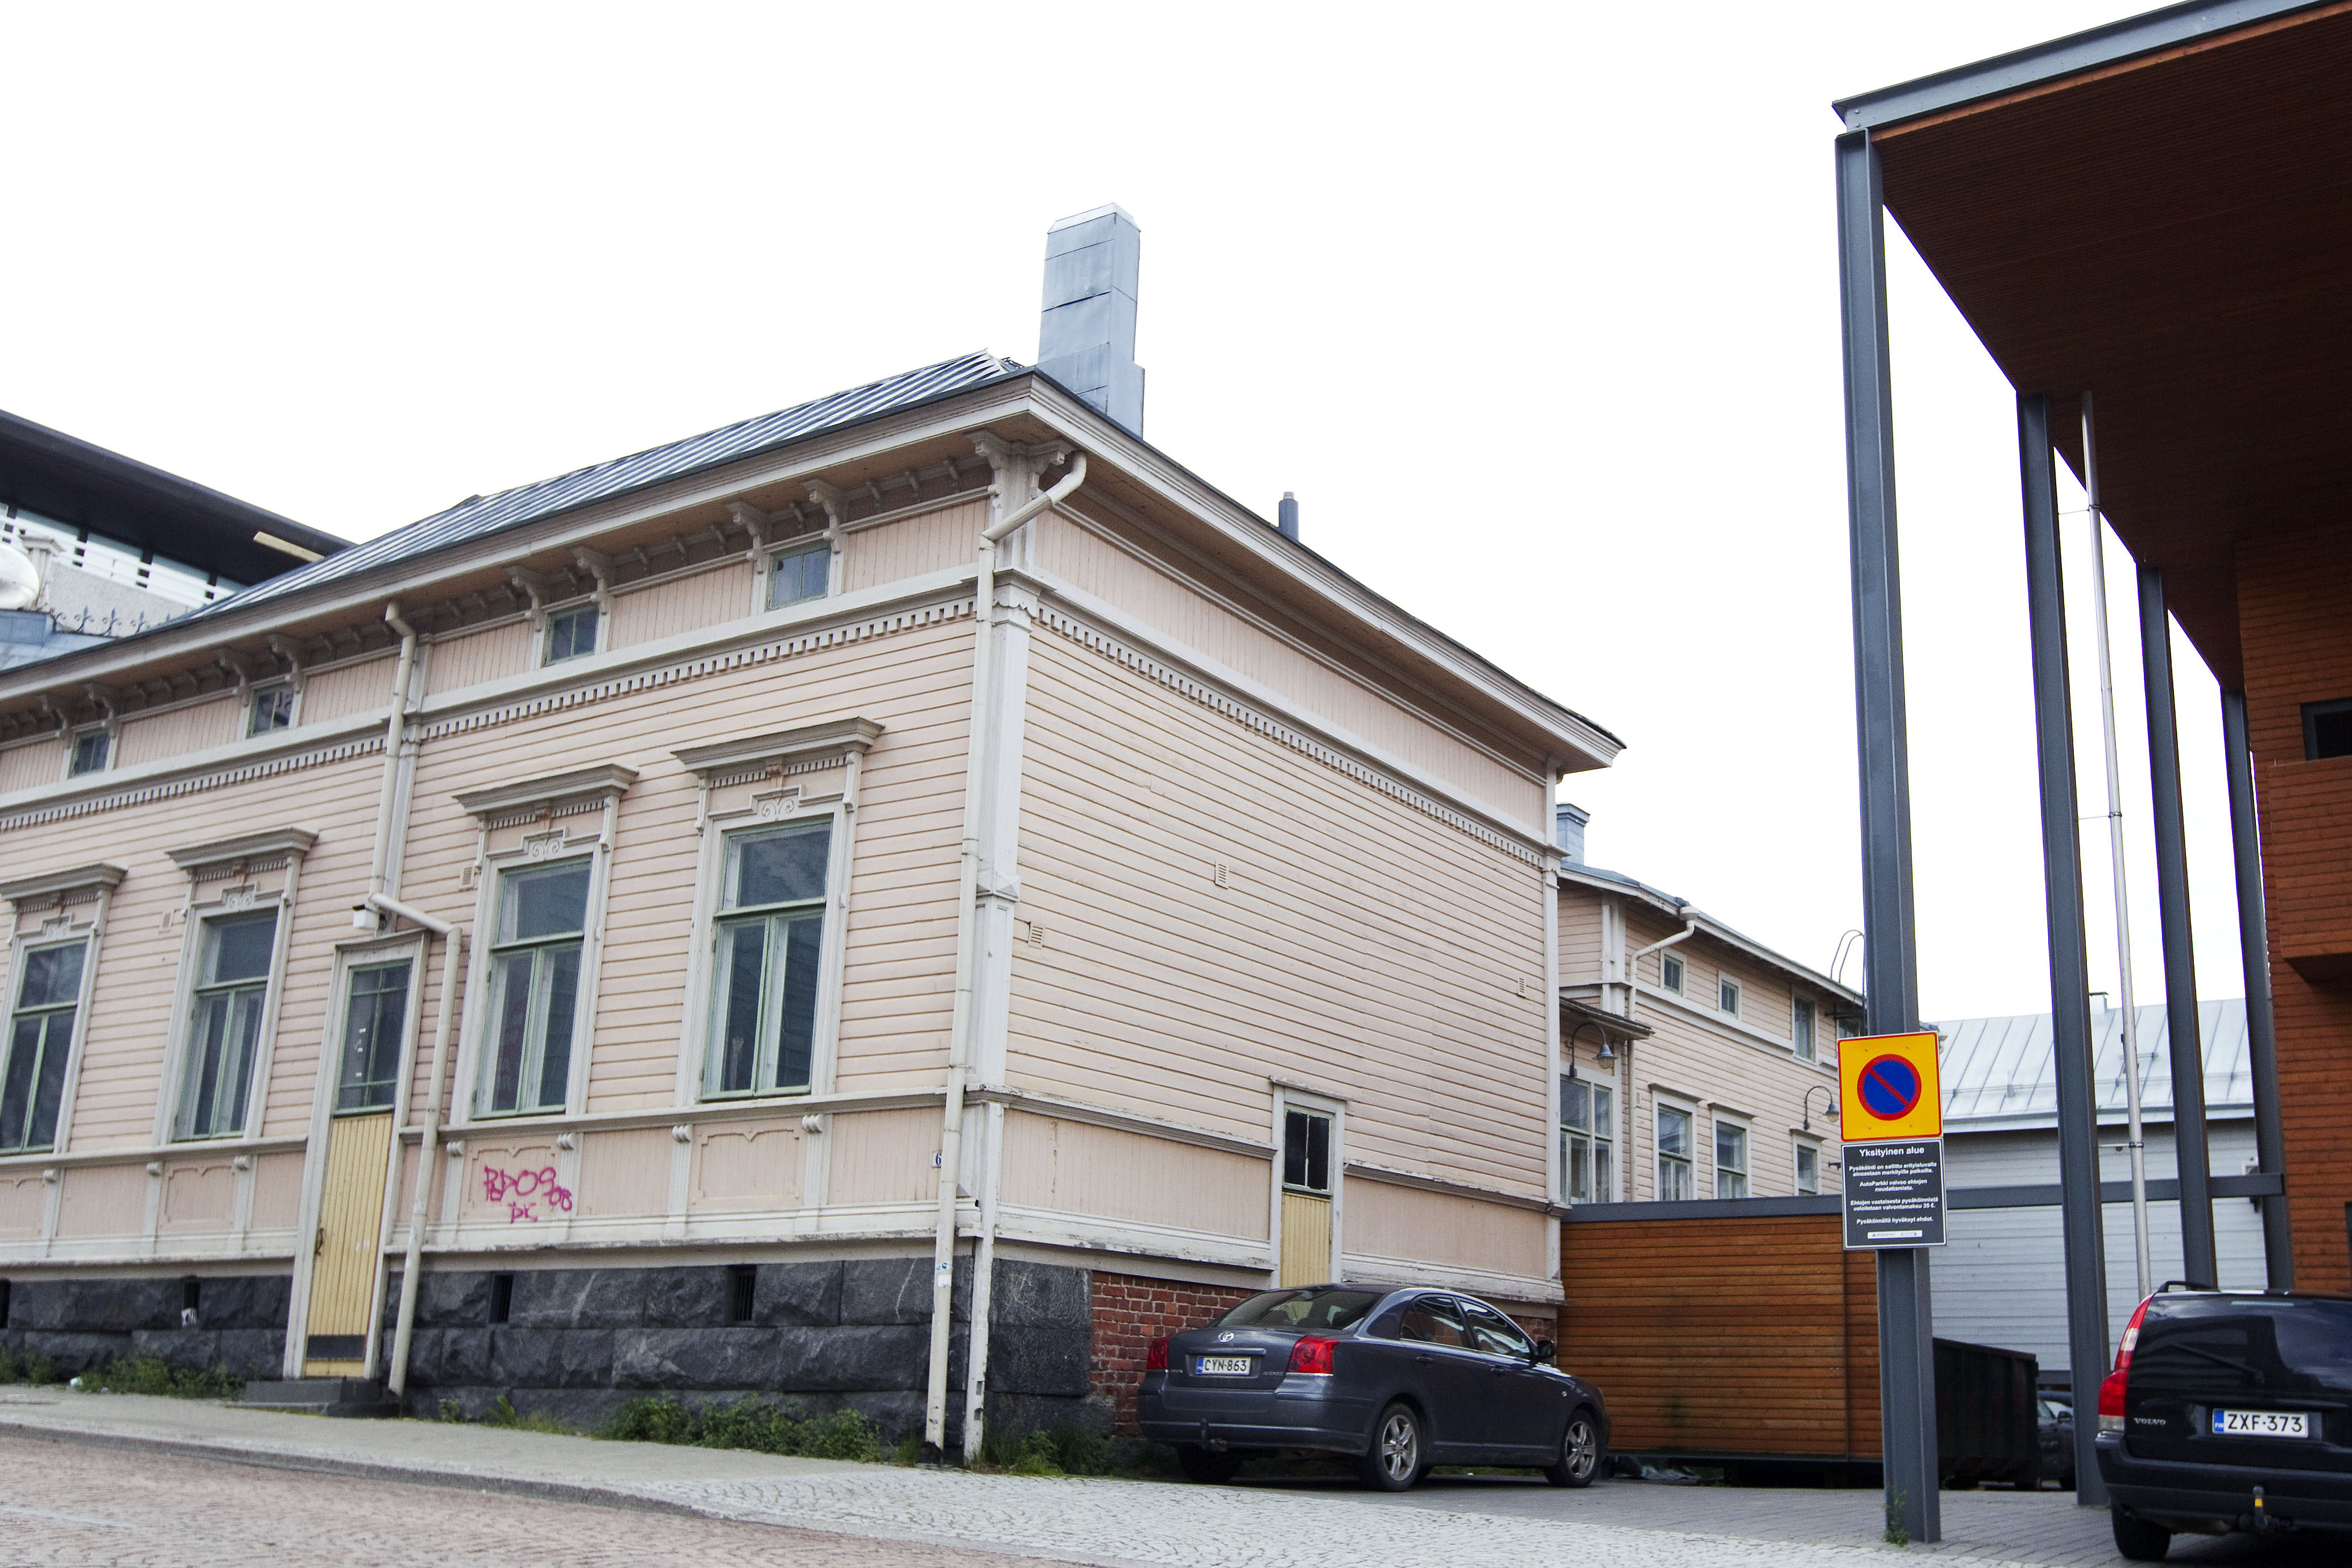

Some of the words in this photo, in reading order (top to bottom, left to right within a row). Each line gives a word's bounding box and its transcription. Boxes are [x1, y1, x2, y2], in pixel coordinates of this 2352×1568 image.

[1859, 1148, 1904, 1157] Yksityinen
[1204, 1359, 1247, 1372] CYN-863
[2134, 1417, 2167, 1426] VOLVO
[2227, 1413, 2303, 1433] ZXF-373
